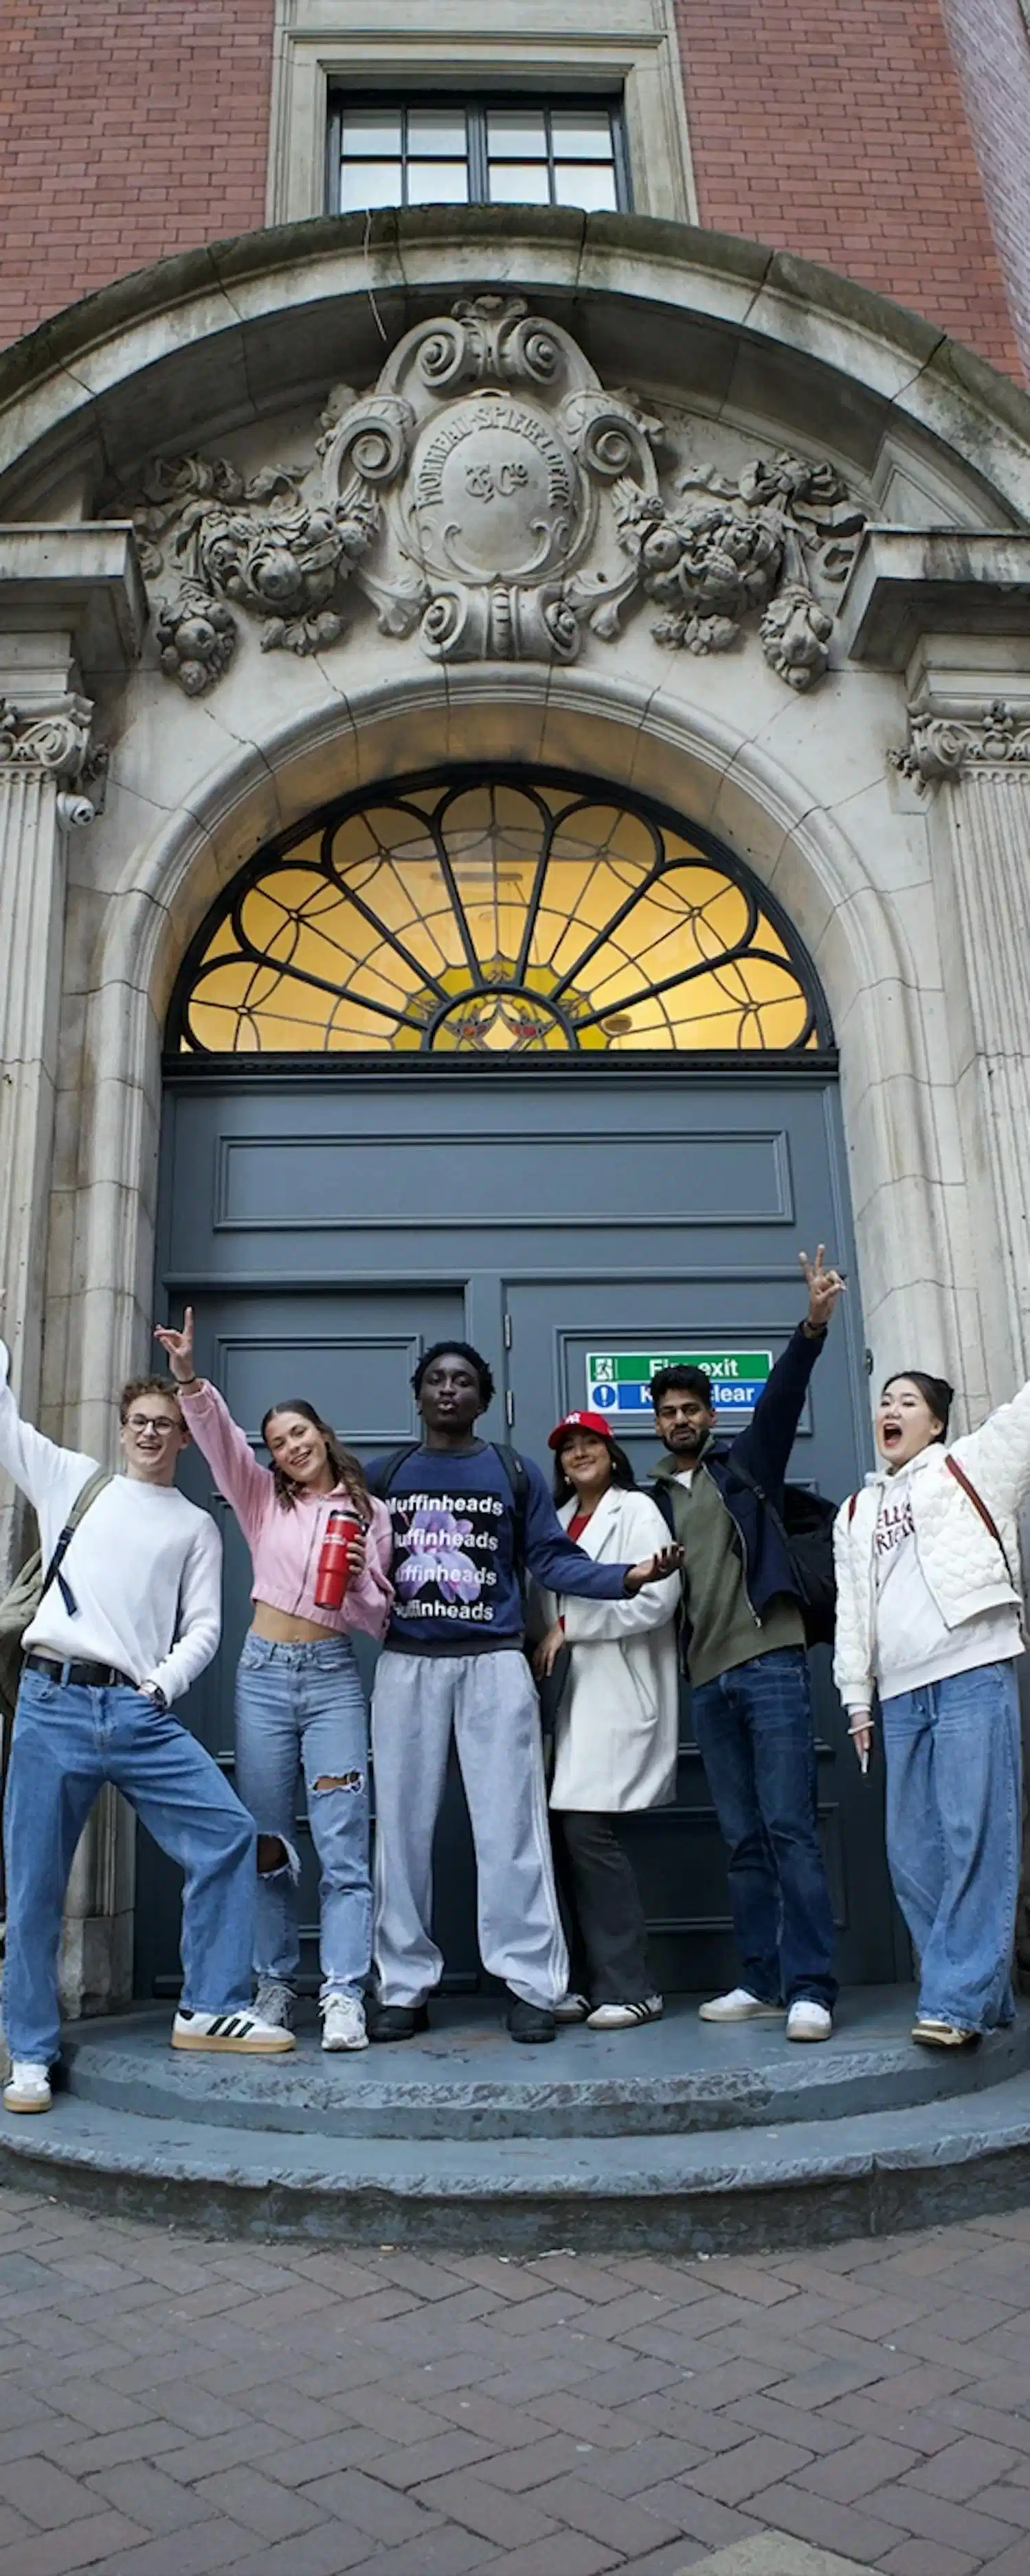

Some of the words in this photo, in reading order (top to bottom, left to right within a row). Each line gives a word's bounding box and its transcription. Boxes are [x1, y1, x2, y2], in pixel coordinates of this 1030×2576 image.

[697, 1357, 740, 1377] exit
[710, 1383, 755, 1403] lear
[394, 1528, 500, 1551] uffinheads
